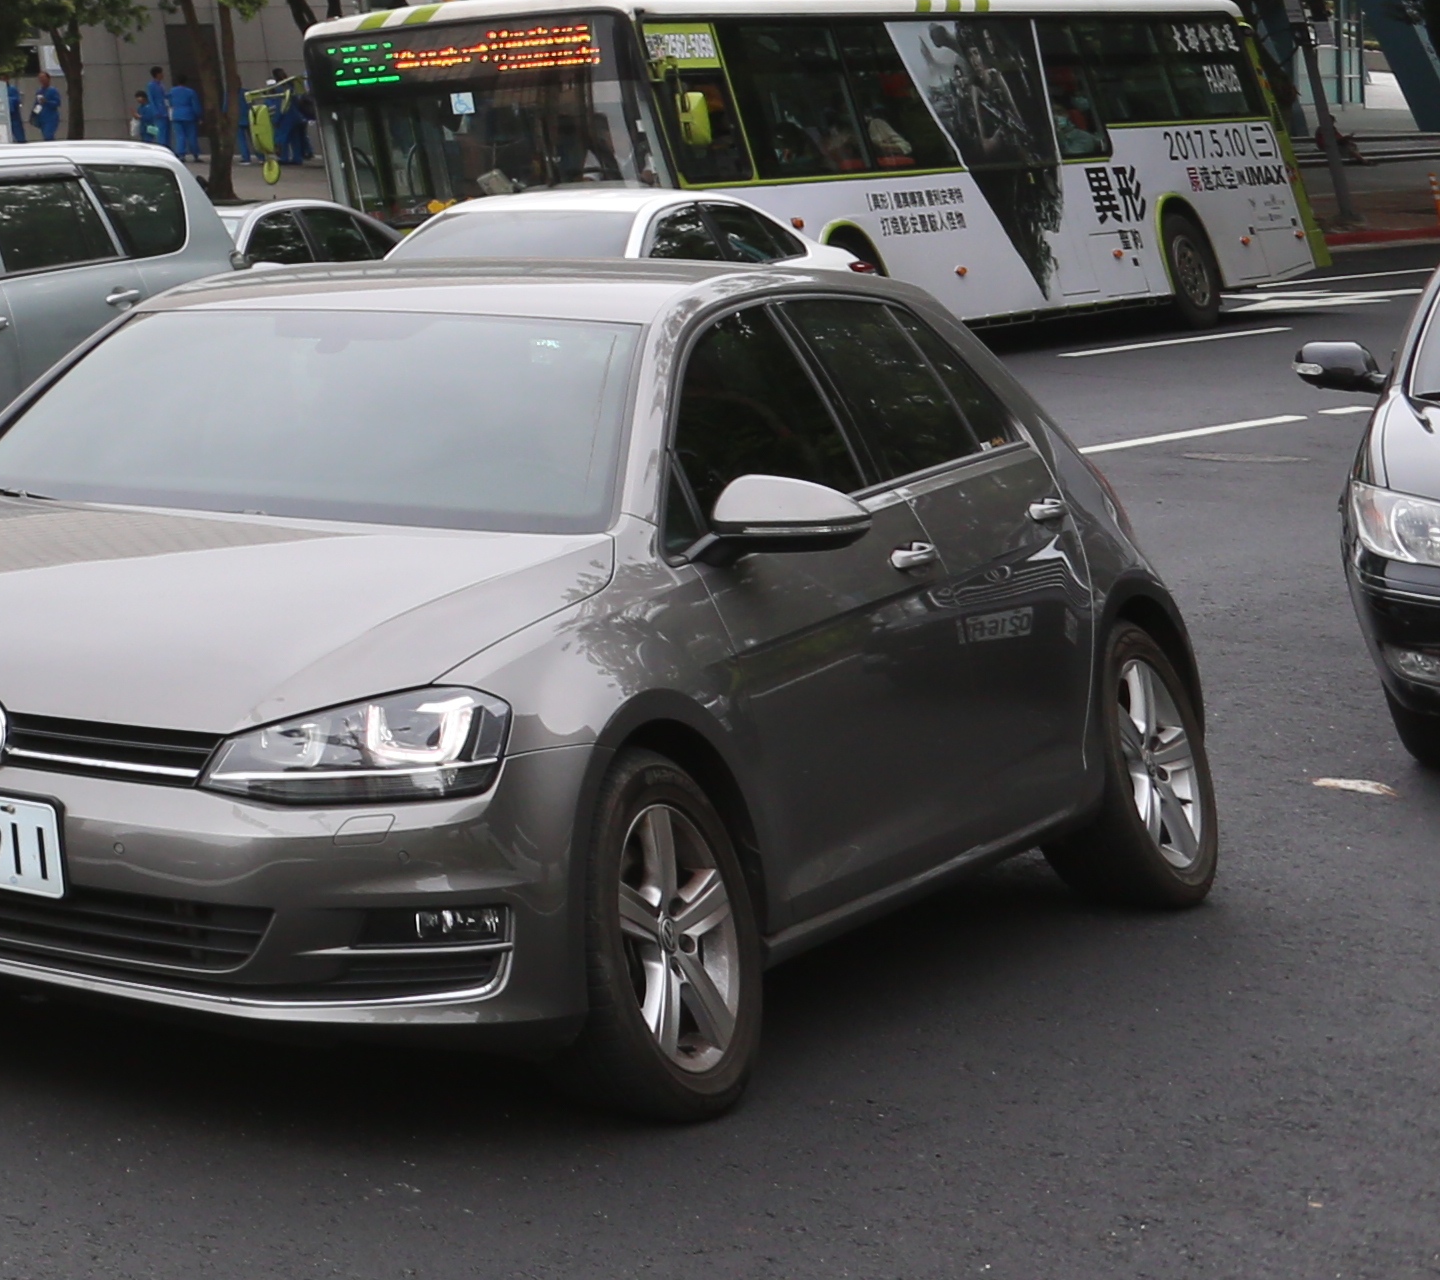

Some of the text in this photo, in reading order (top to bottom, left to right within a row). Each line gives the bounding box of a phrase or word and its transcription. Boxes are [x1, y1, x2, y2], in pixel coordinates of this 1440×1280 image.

[1172, 24, 1239, 52] 大都會客運
[1245, 164, 1286, 187] IMAX
[1084, 165, 1147, 225] 異形
